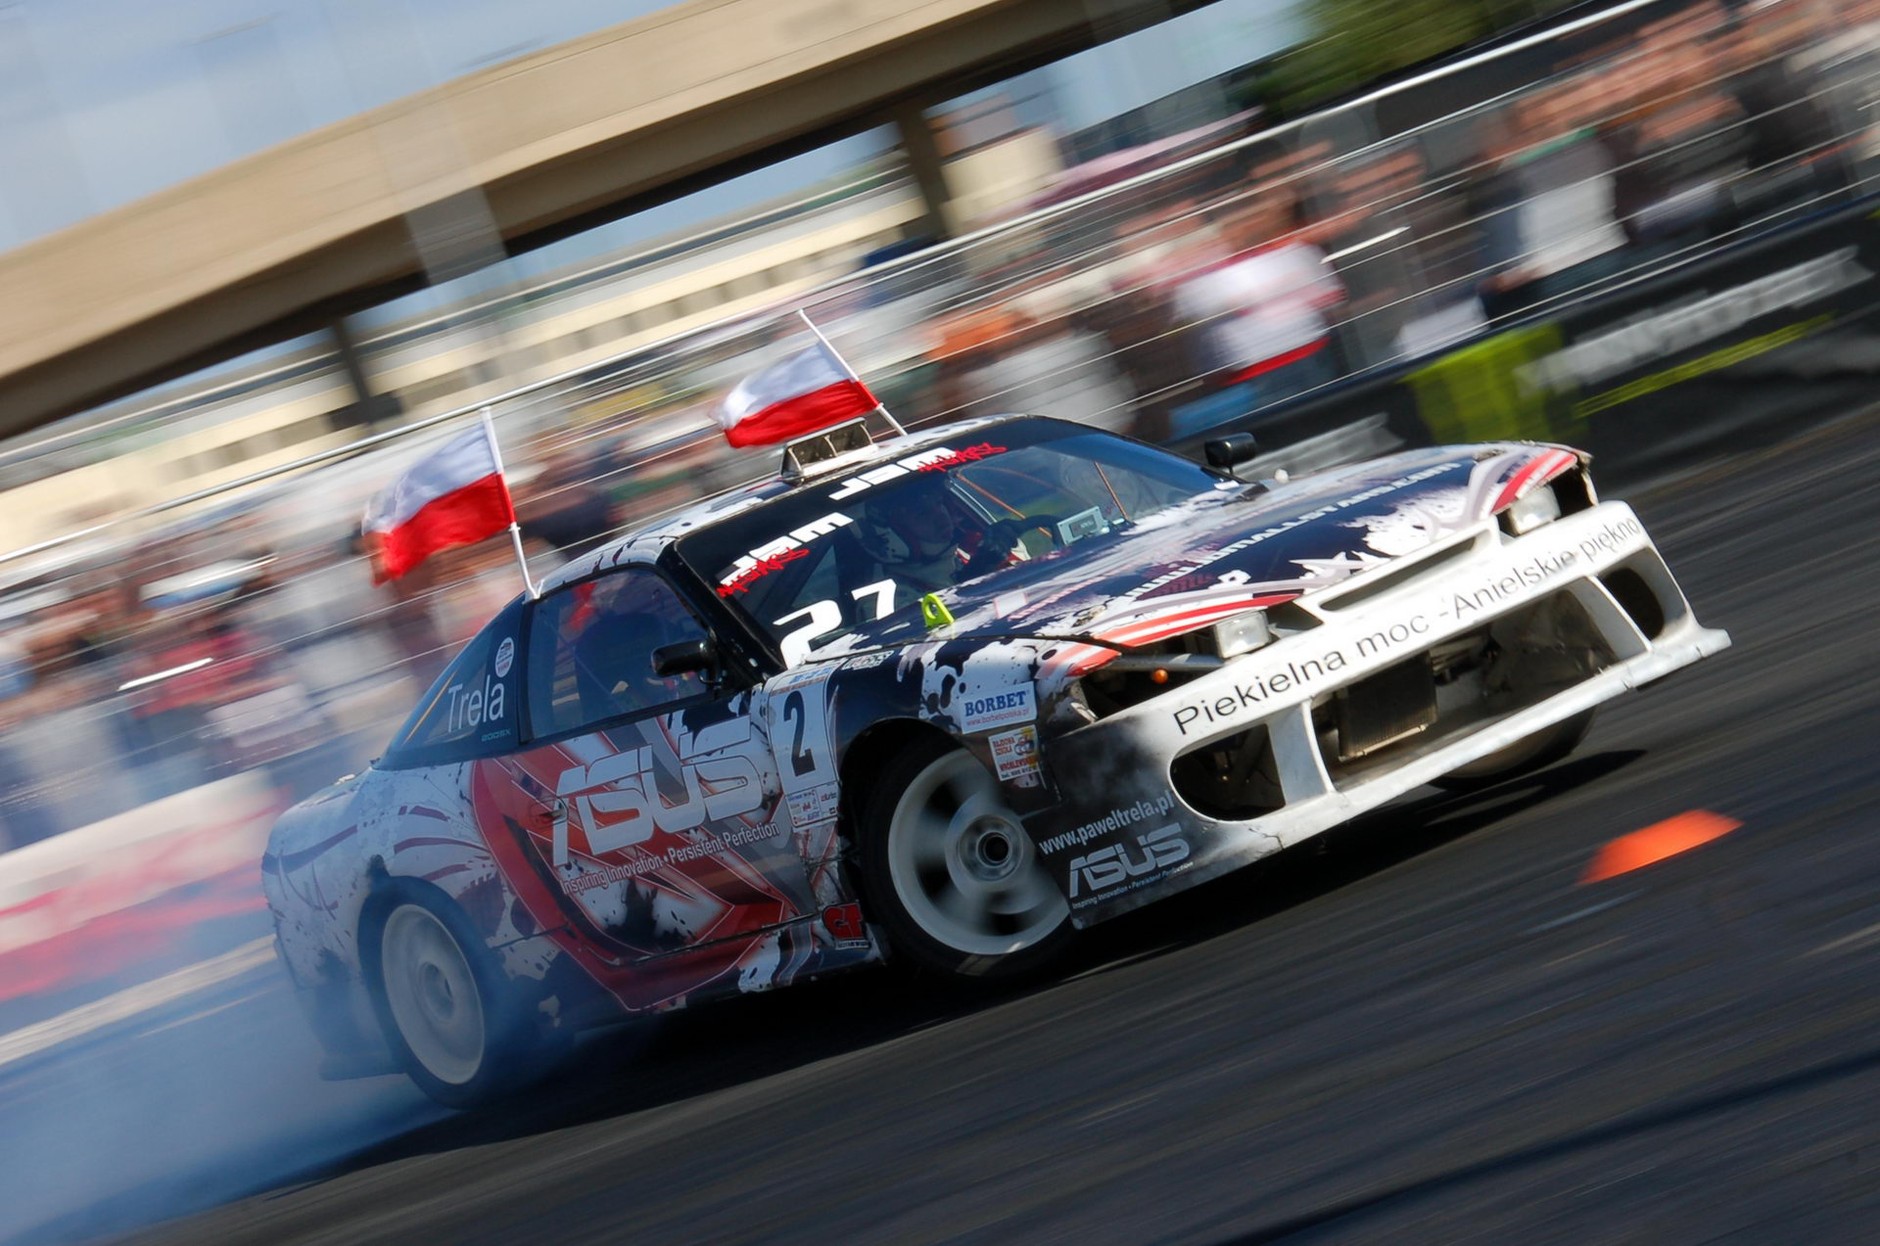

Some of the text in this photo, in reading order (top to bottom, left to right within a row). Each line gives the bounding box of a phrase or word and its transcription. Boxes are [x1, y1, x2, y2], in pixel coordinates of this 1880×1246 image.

[1173, 646, 1347, 735] Piekielna
[1356, 611, 1430, 659] moc
[1579, 517, 1641, 562] piękno
[447, 674, 505, 734] Trela
[783, 690, 816, 777] 2
[964, 690, 1027, 717] BORBET
[553, 716, 763, 867] ASUS
[1039, 790, 1175, 855] www.paweltrela.pl
[560, 820, 780, 895] Inspiring Innovation Persistent Perfection
[1069, 823, 1190, 899] ASUS
